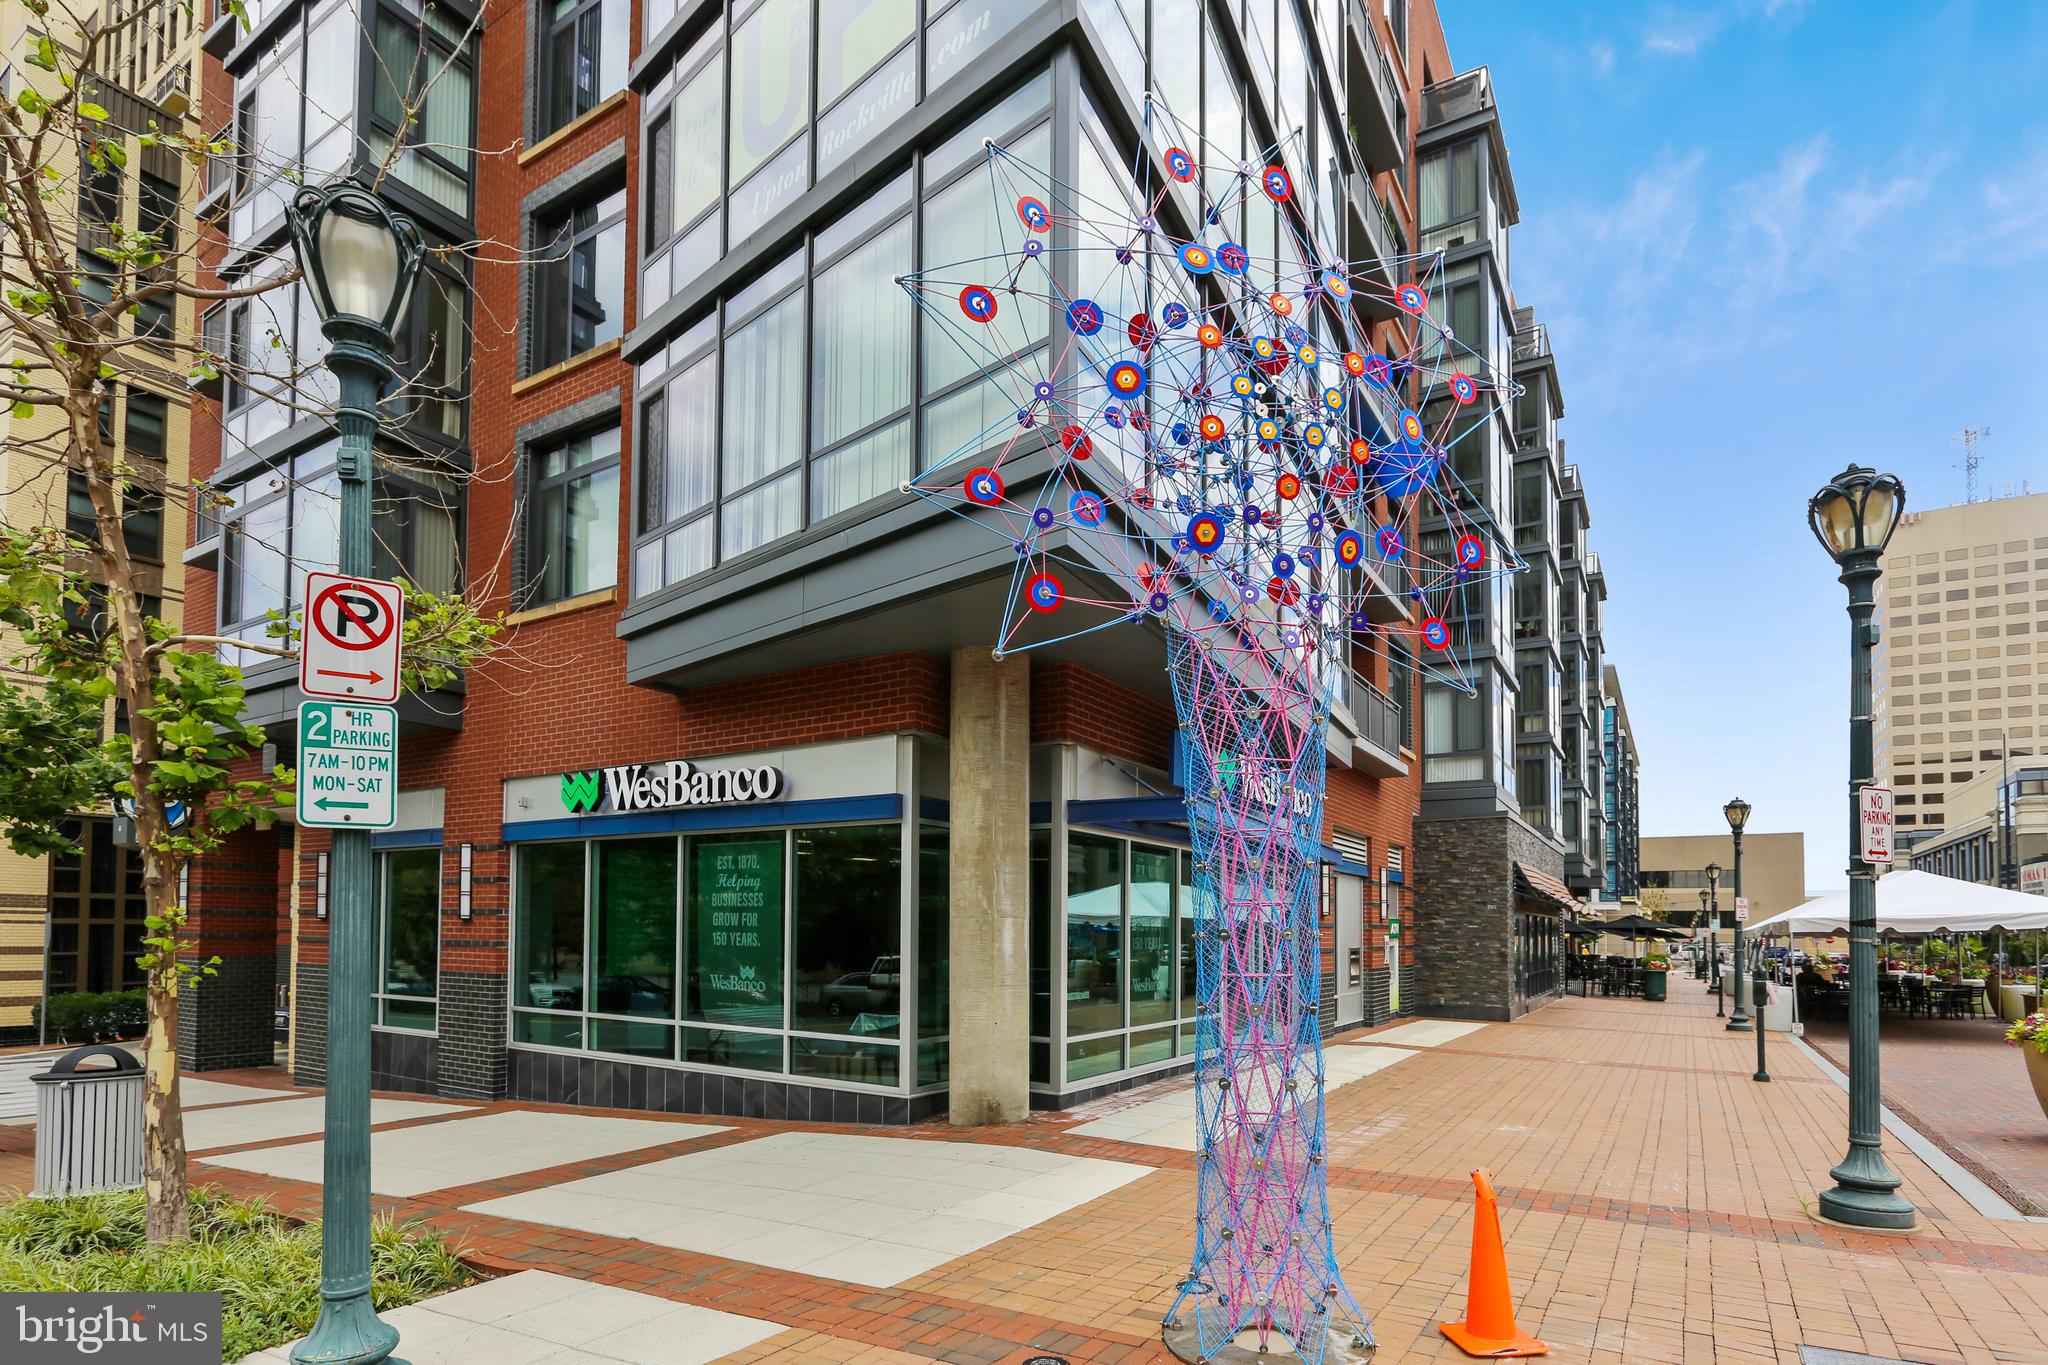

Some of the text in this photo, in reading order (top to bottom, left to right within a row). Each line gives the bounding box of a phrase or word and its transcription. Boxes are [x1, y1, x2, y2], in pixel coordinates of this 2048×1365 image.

[821, 69, 916, 159] Rockville
[306, 710, 373, 741] 2 HR
[333, 729, 391, 747] PARKING
[604, 760, 778, 811] WesBanco
[1870, 795, 1883, 809] NO
[1863, 810, 1891, 825] PARKING
[1871, 826, 1884, 836] ANY
[1870, 837, 1885, 847] TIME
[717, 854, 760, 870] EST. 1870.
[715, 873, 761, 891] Helping
[711, 892, 764, 907] BUSINESSES
[712, 912, 758, 927] GROW FOR
[712, 932, 761, 947] 150 YEARS.
[710, 974, 766, 992] WesBanco
